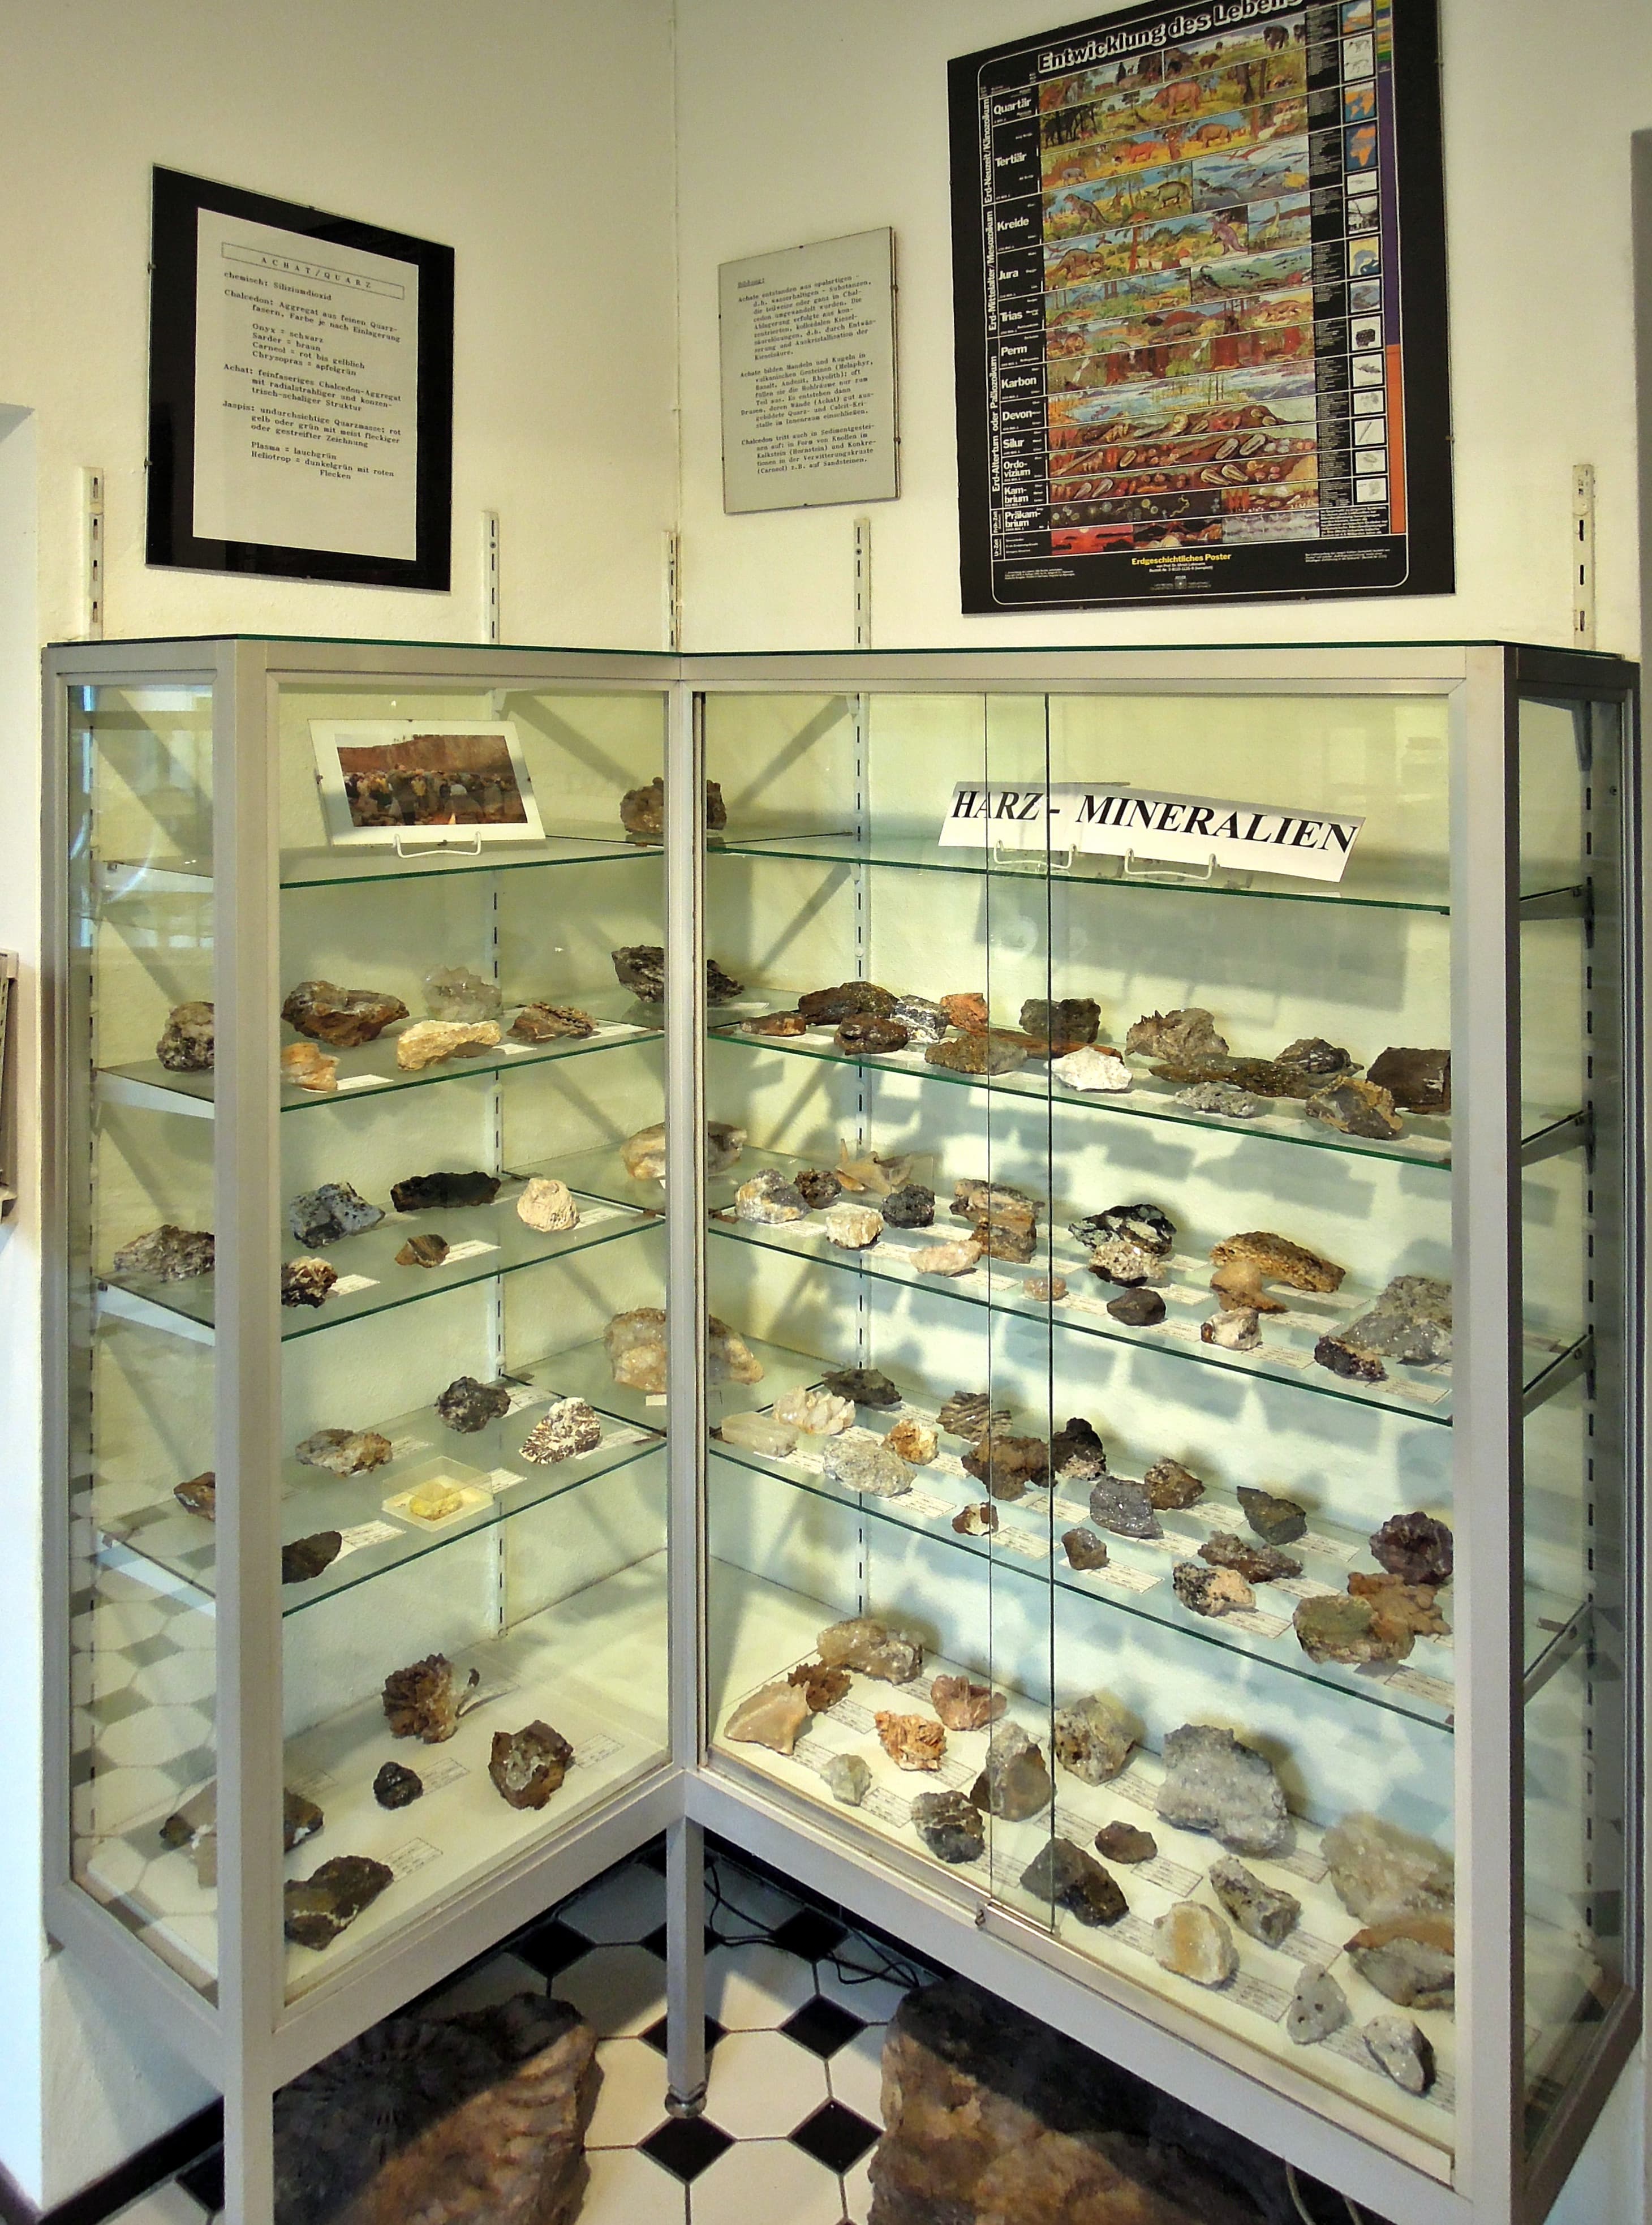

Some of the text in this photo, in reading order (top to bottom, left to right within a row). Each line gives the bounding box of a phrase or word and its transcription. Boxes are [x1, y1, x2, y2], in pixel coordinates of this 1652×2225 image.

[1038, 23, 1165, 74] Entwicklung
[1168, 15, 1210, 40] des
[993, 98, 1032, 115] Quartär
[995, 152, 1027, 167] Tertiär
[997, 217, 1030, 231] Kreide
[223, 271, 267, 286] chemisch:
[999, 269, 1019, 281] Jura
[279, 301, 318, 315] Aggregat
[341, 314, 365, 325] feinen
[370, 321, 397, 332] Quarz-
[290, 312, 313, 323] Farbe
[330, 322, 349, 330] nach
[1000, 311, 1023, 323] Trias
[252, 323, 323, 343] Onyx schwarz
[252, 332, 320, 351] Sarder braun
[252, 341, 285, 353] Carneol
[316, 353, 328, 362] bis
[333, 358, 364, 369] gelblich
[1001, 345, 1027, 356] Perm
[223, 363, 252, 374] Achat:
[315, 364, 356, 376] apfelgrün
[990, 356, 998, 409] Paläozoikum
[1001, 377, 1037, 389] Karbon
[222, 400, 255, 411] Jaspis:
[325, 400, 362, 411] Struktur
[360, 396, 392, 407] konzen-
[1003, 409, 1032, 421] Devon
[326, 435, 368, 448] Zeichnung
[364, 432, 399, 443] fleckiger
[1003, 438, 1025, 449] Silur
[251, 441, 336, 459] Plasma lauchgrün
[251, 450, 291, 463] Heliotrop
[992, 435, 1000, 492] Erd-Altertum
[1003, 459, 1028, 470] Ordo-
[320, 469, 351, 479] Flecken
[1004, 468, 1031, 478] vizium
[1004, 486, 1027, 495] Kam-
[1004, 493, 1029, 504] brium
[1005, 510, 1041, 521] Präkam-
[1005, 519, 1030, 529] brium
[1132, 555, 1203, 566] Erdgeschichtliches
[1204, 553, 1232, 562] Poster
[950, 791, 1358, 853] HARZ- MINERALIEN
